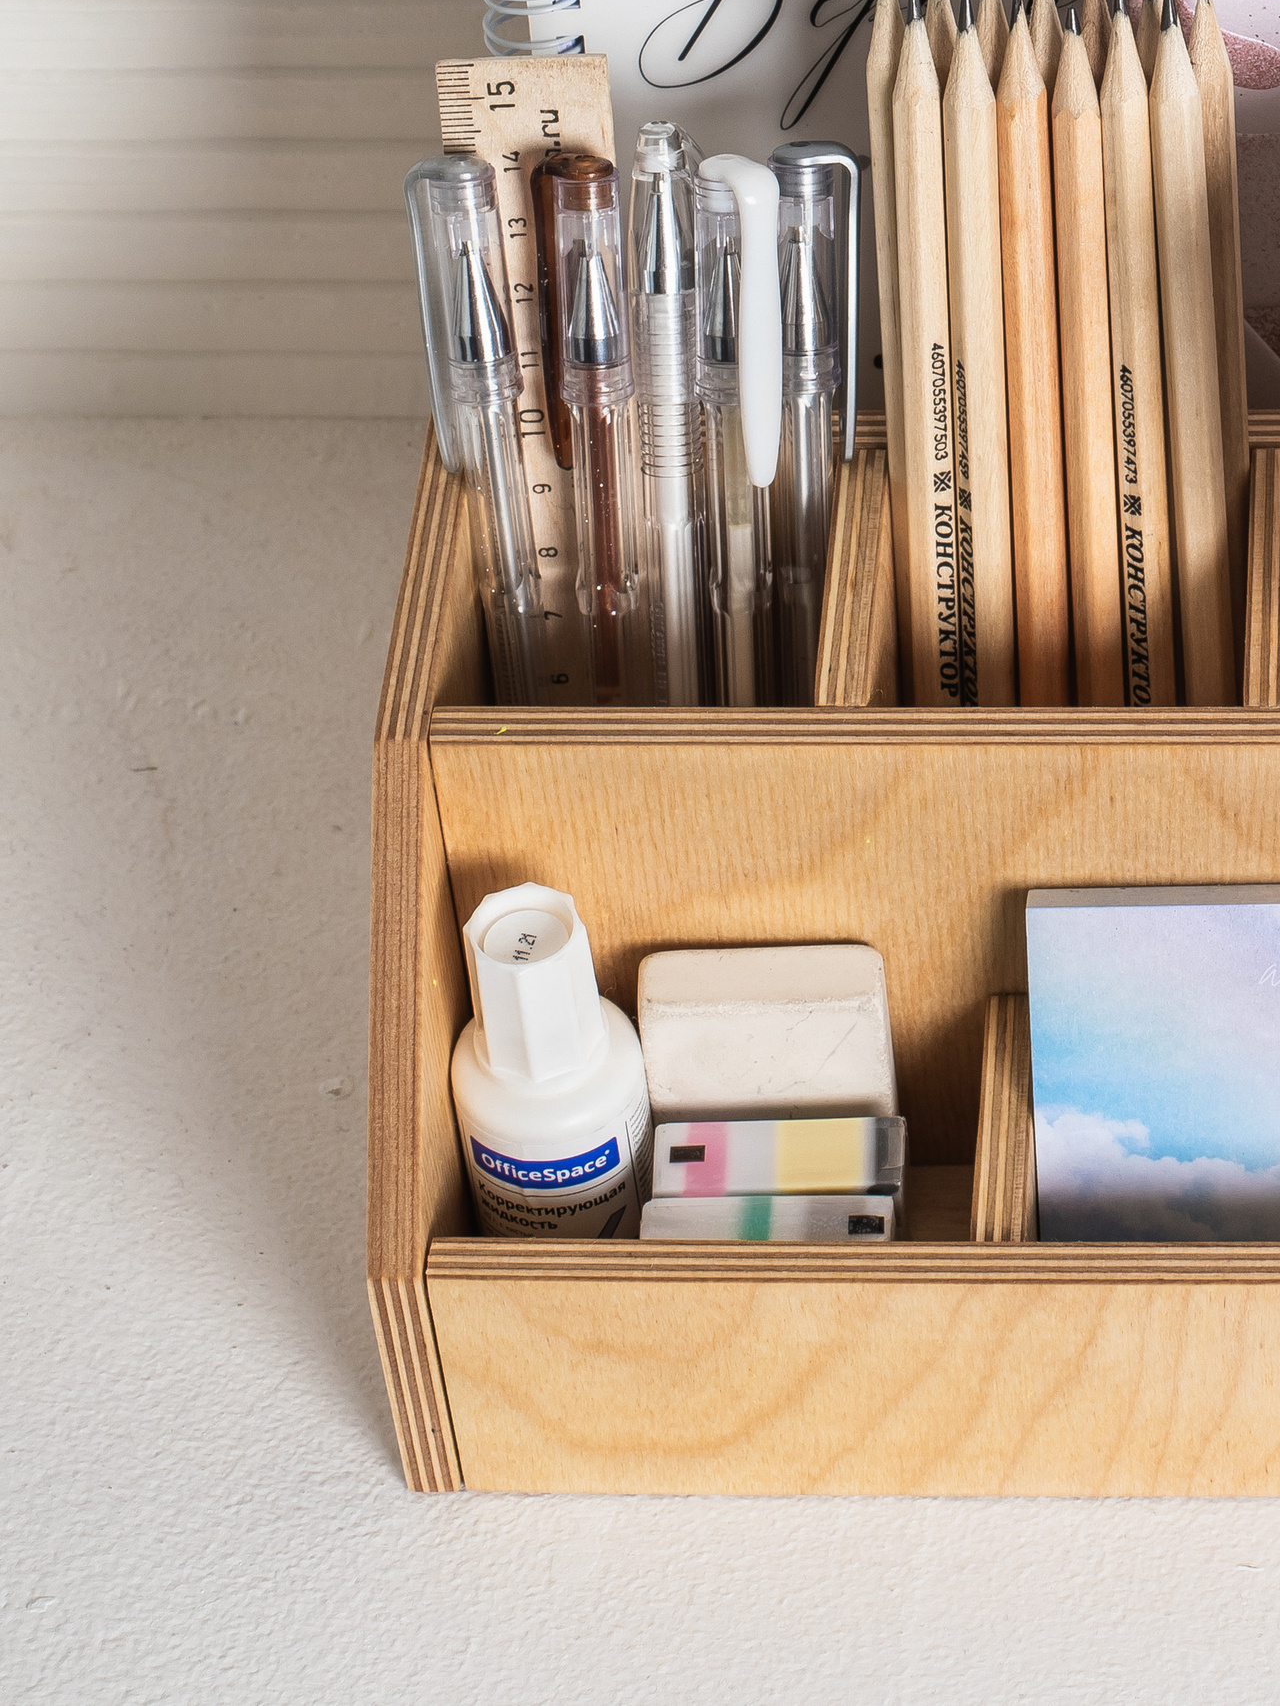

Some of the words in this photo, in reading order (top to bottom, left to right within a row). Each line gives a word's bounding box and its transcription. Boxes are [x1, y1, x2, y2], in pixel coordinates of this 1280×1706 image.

[487, 81, 516, 111] 15
[502, 150, 521, 172] 14
[508, 217, 527, 239] 13
[514, 282, 534, 304] 12
[520, 351, 540, 370] 11
[931, 342, 949, 462] 4607055397503
[519, 408, 546, 439] 10
[1120, 364, 1138, 485] 4607055397473
[532, 483, 552, 495] 9
[538, 546, 558, 559] 8
[934, 503, 959, 699] КОНСТРУКТОР
[1125, 523, 1151, 707] КОНСТРУКТО
[481, 1152, 608, 1184] OfficeSpace
[478, 1179, 627, 1219] Корректирующая
[481, 1200, 560, 1231] жидкость
